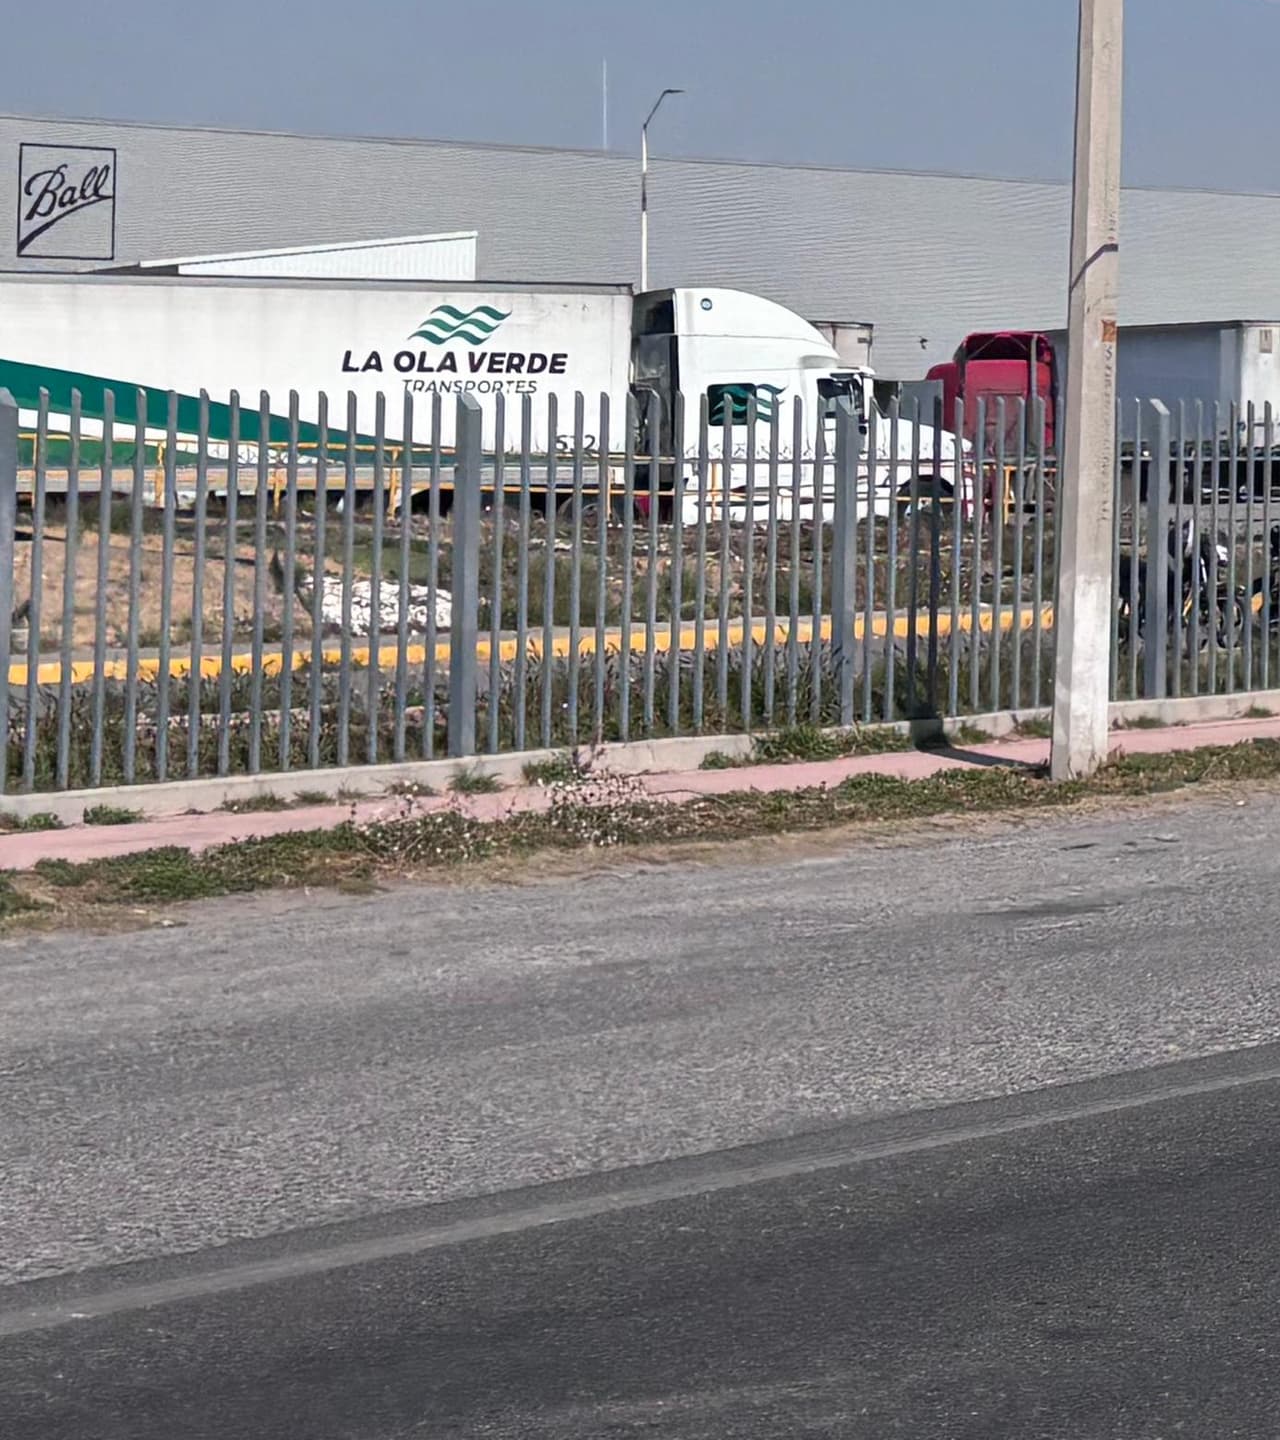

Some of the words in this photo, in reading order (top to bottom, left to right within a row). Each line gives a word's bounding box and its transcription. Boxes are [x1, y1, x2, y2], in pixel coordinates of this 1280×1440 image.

[23, 163, 111, 221] Ball
[341, 350, 383, 373] LA
[393, 350, 458, 373] OLA
[468, 351, 569, 375] VERDE
[401, 378, 538, 394] TRANSPORTES
